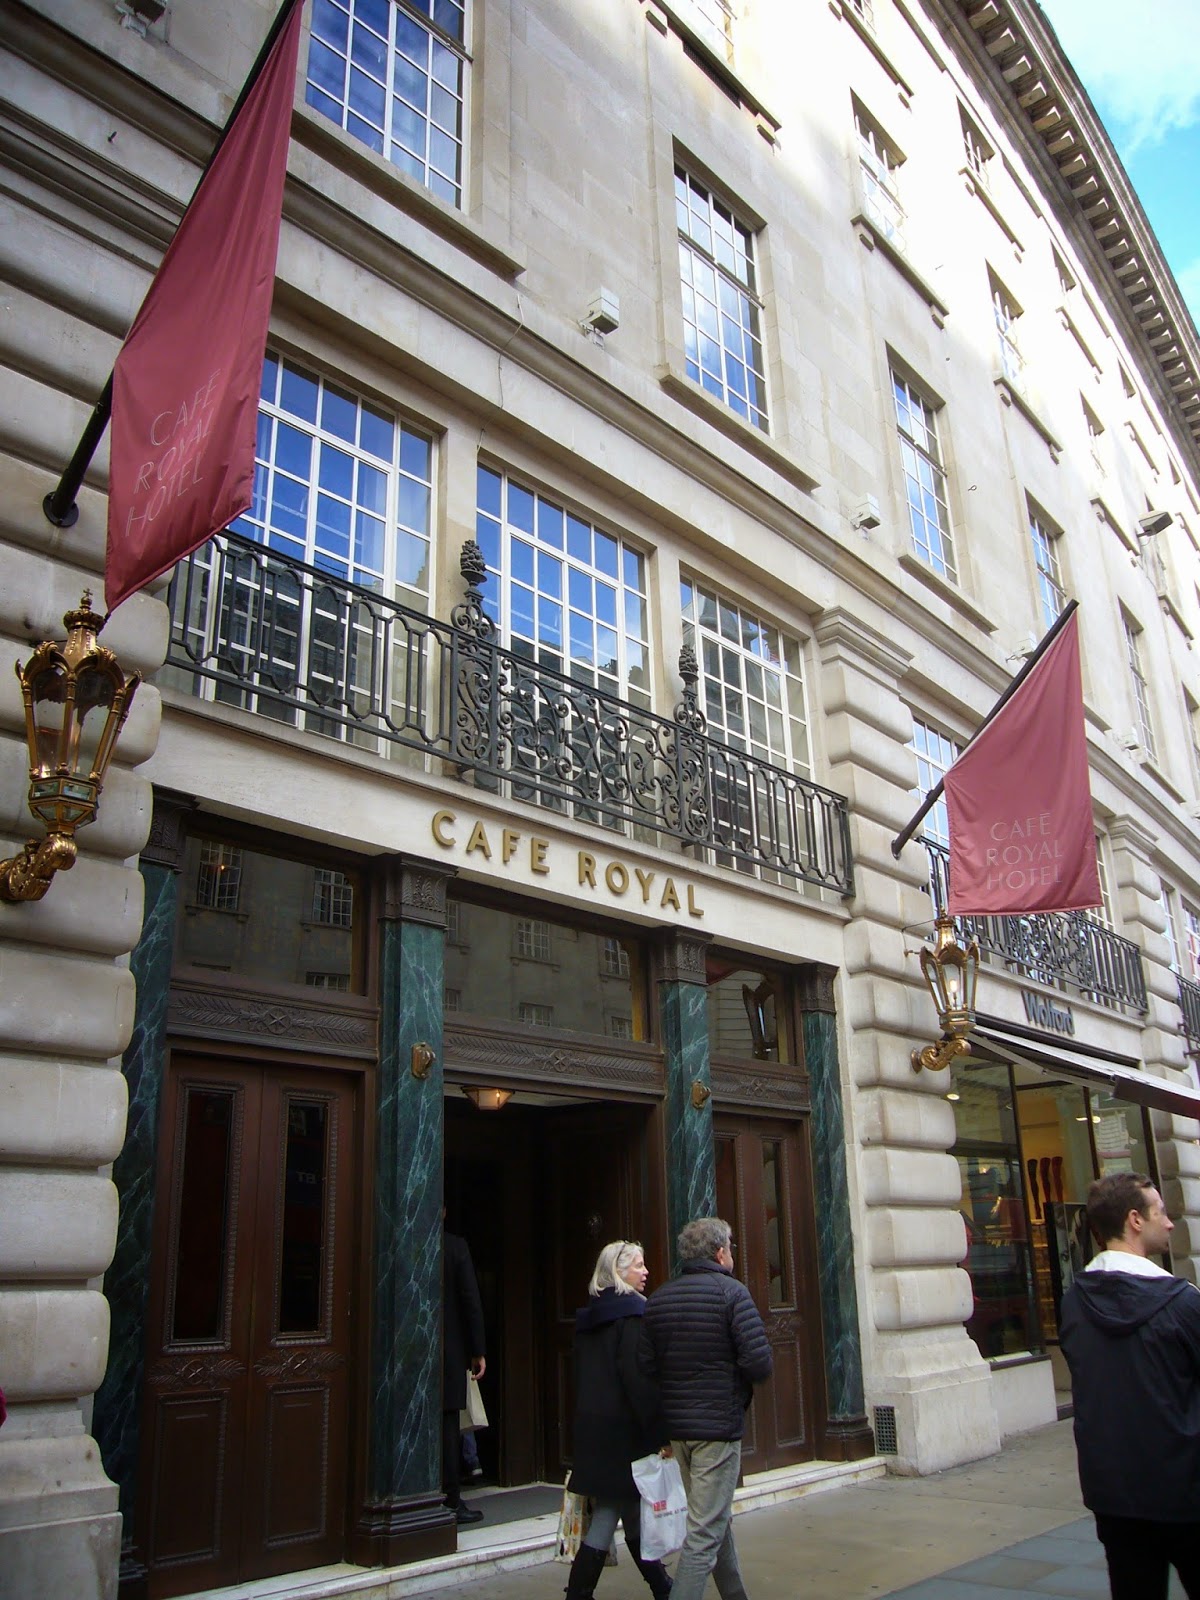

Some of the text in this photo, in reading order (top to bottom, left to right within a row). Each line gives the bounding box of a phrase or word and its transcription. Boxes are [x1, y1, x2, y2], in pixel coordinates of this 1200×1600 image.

[125, 451, 204, 537] HOTEL
[134, 407, 215, 495] ROYAL
[431, 809, 705, 916] CAFE ROYAL
[986, 839, 1063, 867] ROYAL
[986, 864, 1063, 890] HOTEL
